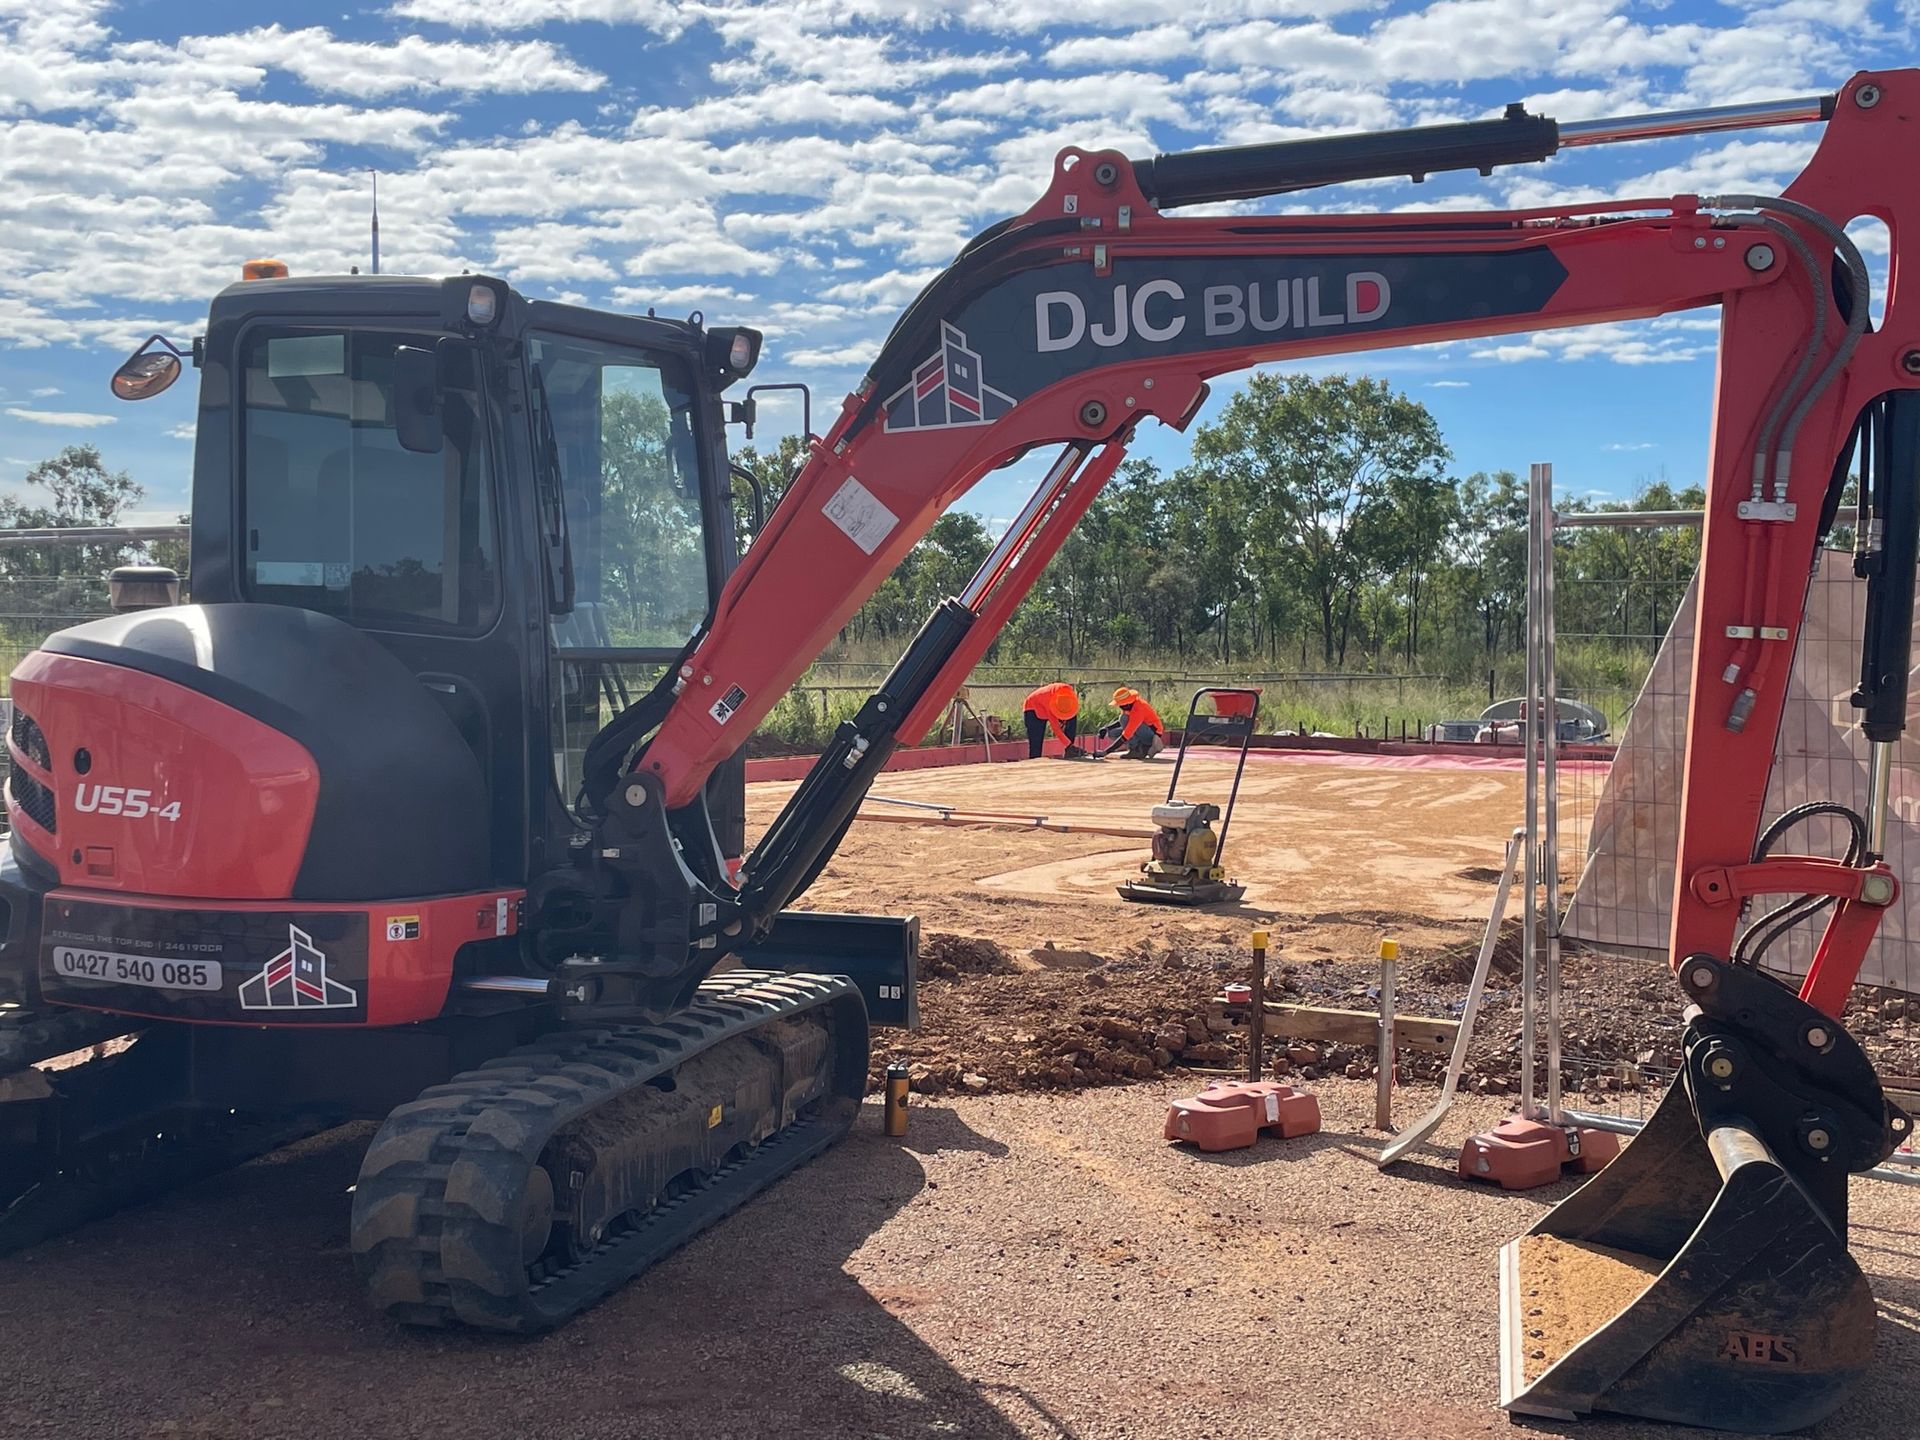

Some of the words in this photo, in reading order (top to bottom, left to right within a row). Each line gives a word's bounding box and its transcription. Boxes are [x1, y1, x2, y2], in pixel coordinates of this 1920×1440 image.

[1035, 279, 1186, 353] DJC
[1203, 271, 1392, 336] BUILD
[75, 783, 181, 821] U55-4
[97, 934, 113, 944] THE
[115, 936, 133, 946] TOP
[135, 939, 154, 949] END
[63, 952, 110, 977] 0427
[116, 958, 155, 982] 540
[162, 963, 208, 986] 085
